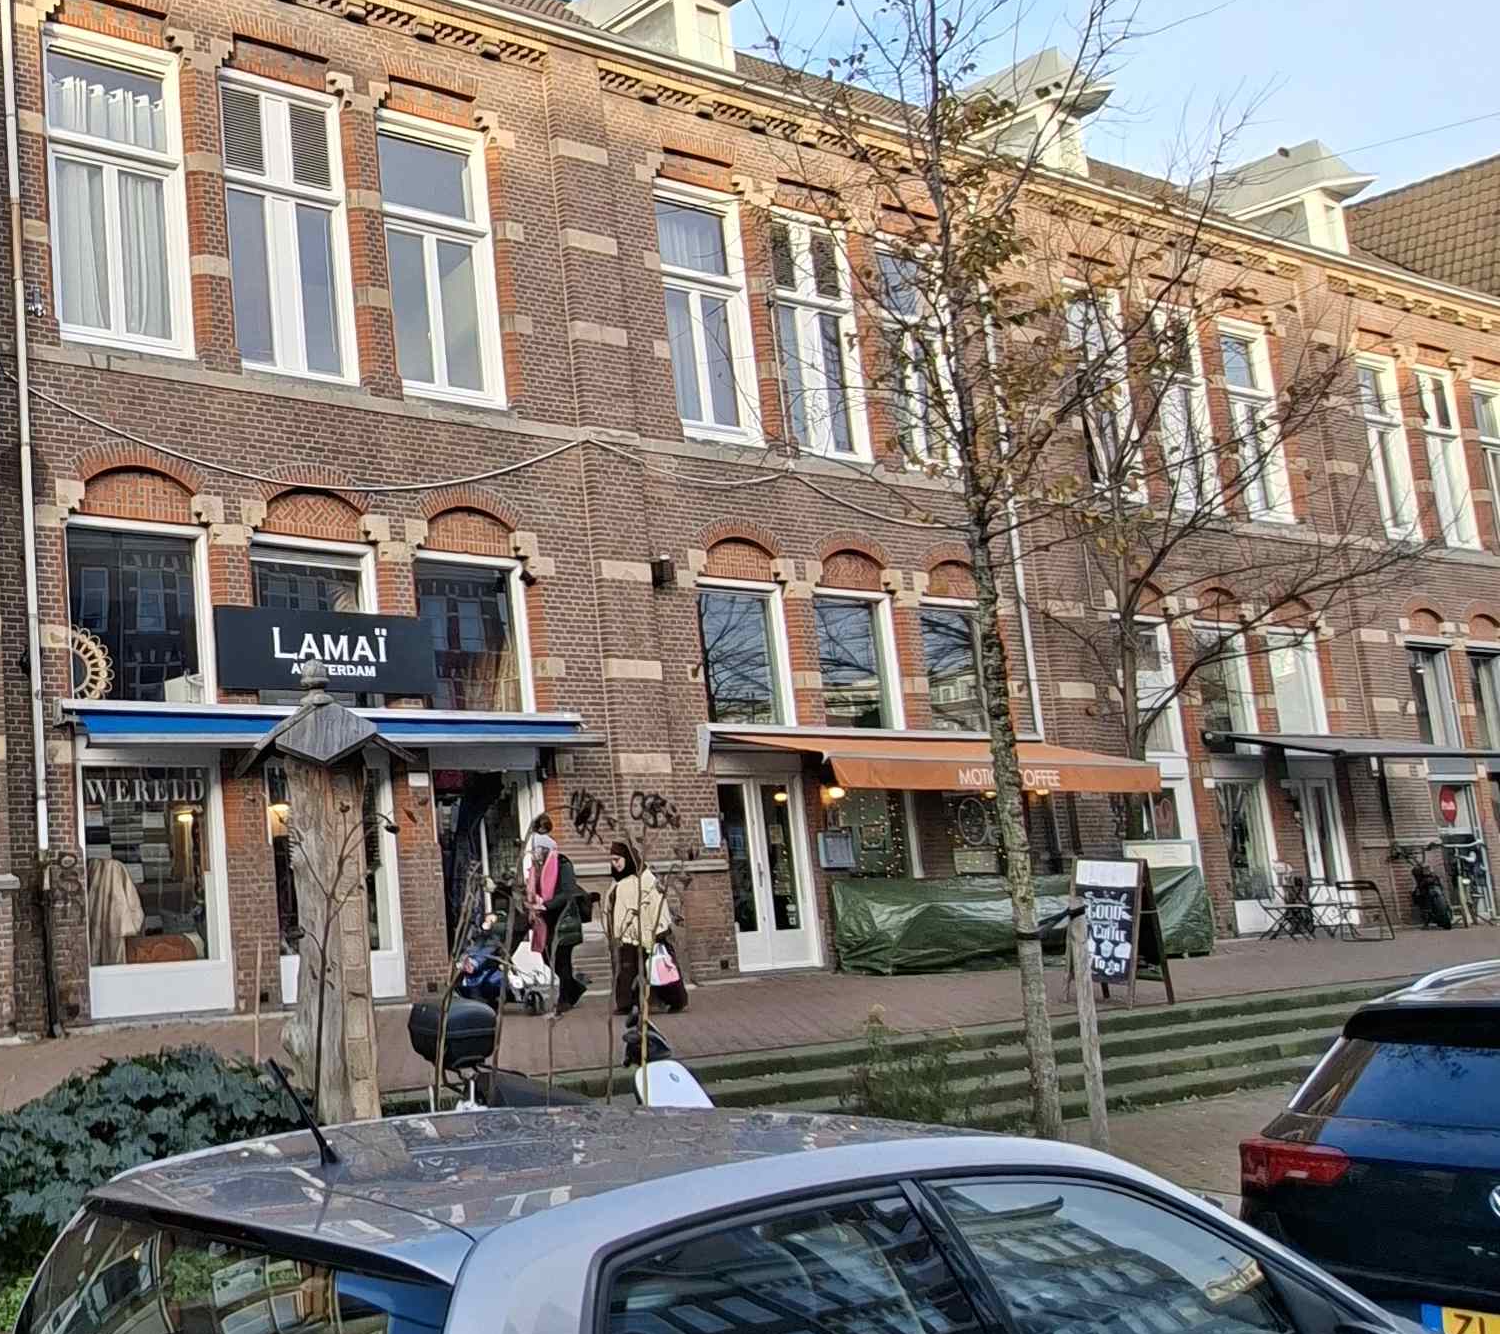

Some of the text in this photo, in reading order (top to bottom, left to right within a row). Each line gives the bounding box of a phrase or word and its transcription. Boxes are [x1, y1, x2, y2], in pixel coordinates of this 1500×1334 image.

[291, 662, 377, 677] AERDAM
[958, 768, 1061, 788] MOTI OFFEE
